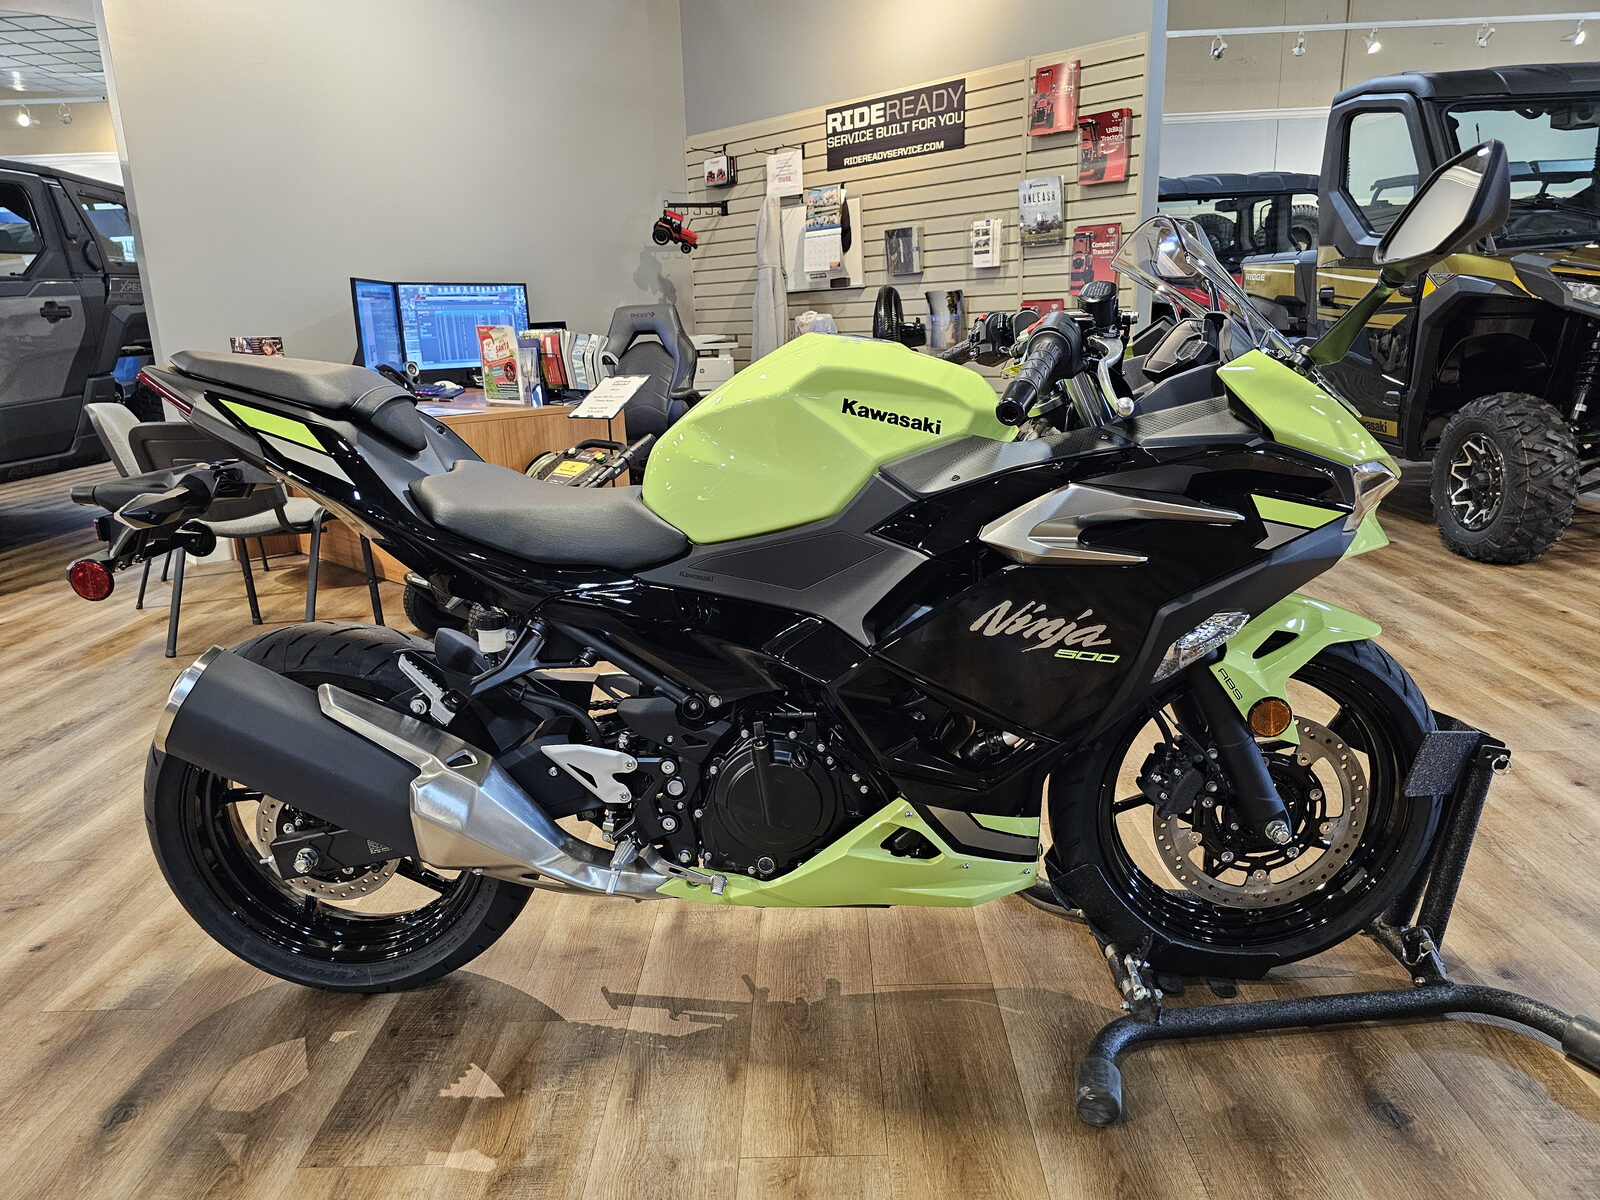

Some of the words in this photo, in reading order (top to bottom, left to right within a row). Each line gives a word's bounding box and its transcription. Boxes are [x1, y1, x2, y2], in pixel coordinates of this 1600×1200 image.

[827, 128, 874, 148] SERVICE
[876, 121, 910, 139] BUILT
[912, 115, 936, 132] FOR
[938, 110, 964, 127] YOU
[1101, 134, 1124, 142] Tractors
[843, 140, 945, 166] RIDEREADYSERVICE.COM
[1022, 190, 1056, 204] UNLEASH
[1091, 241, 1116, 249] Compact
[1245, 273, 1266, 281] RIDGE
[841, 398, 942, 435] Kawasaki
[1362, 420, 1387, 433] asaki
[969, 600, 1112, 653] Ninja
[1053, 648, 1120, 664] 500
[1217, 668, 1243, 700] ABS
